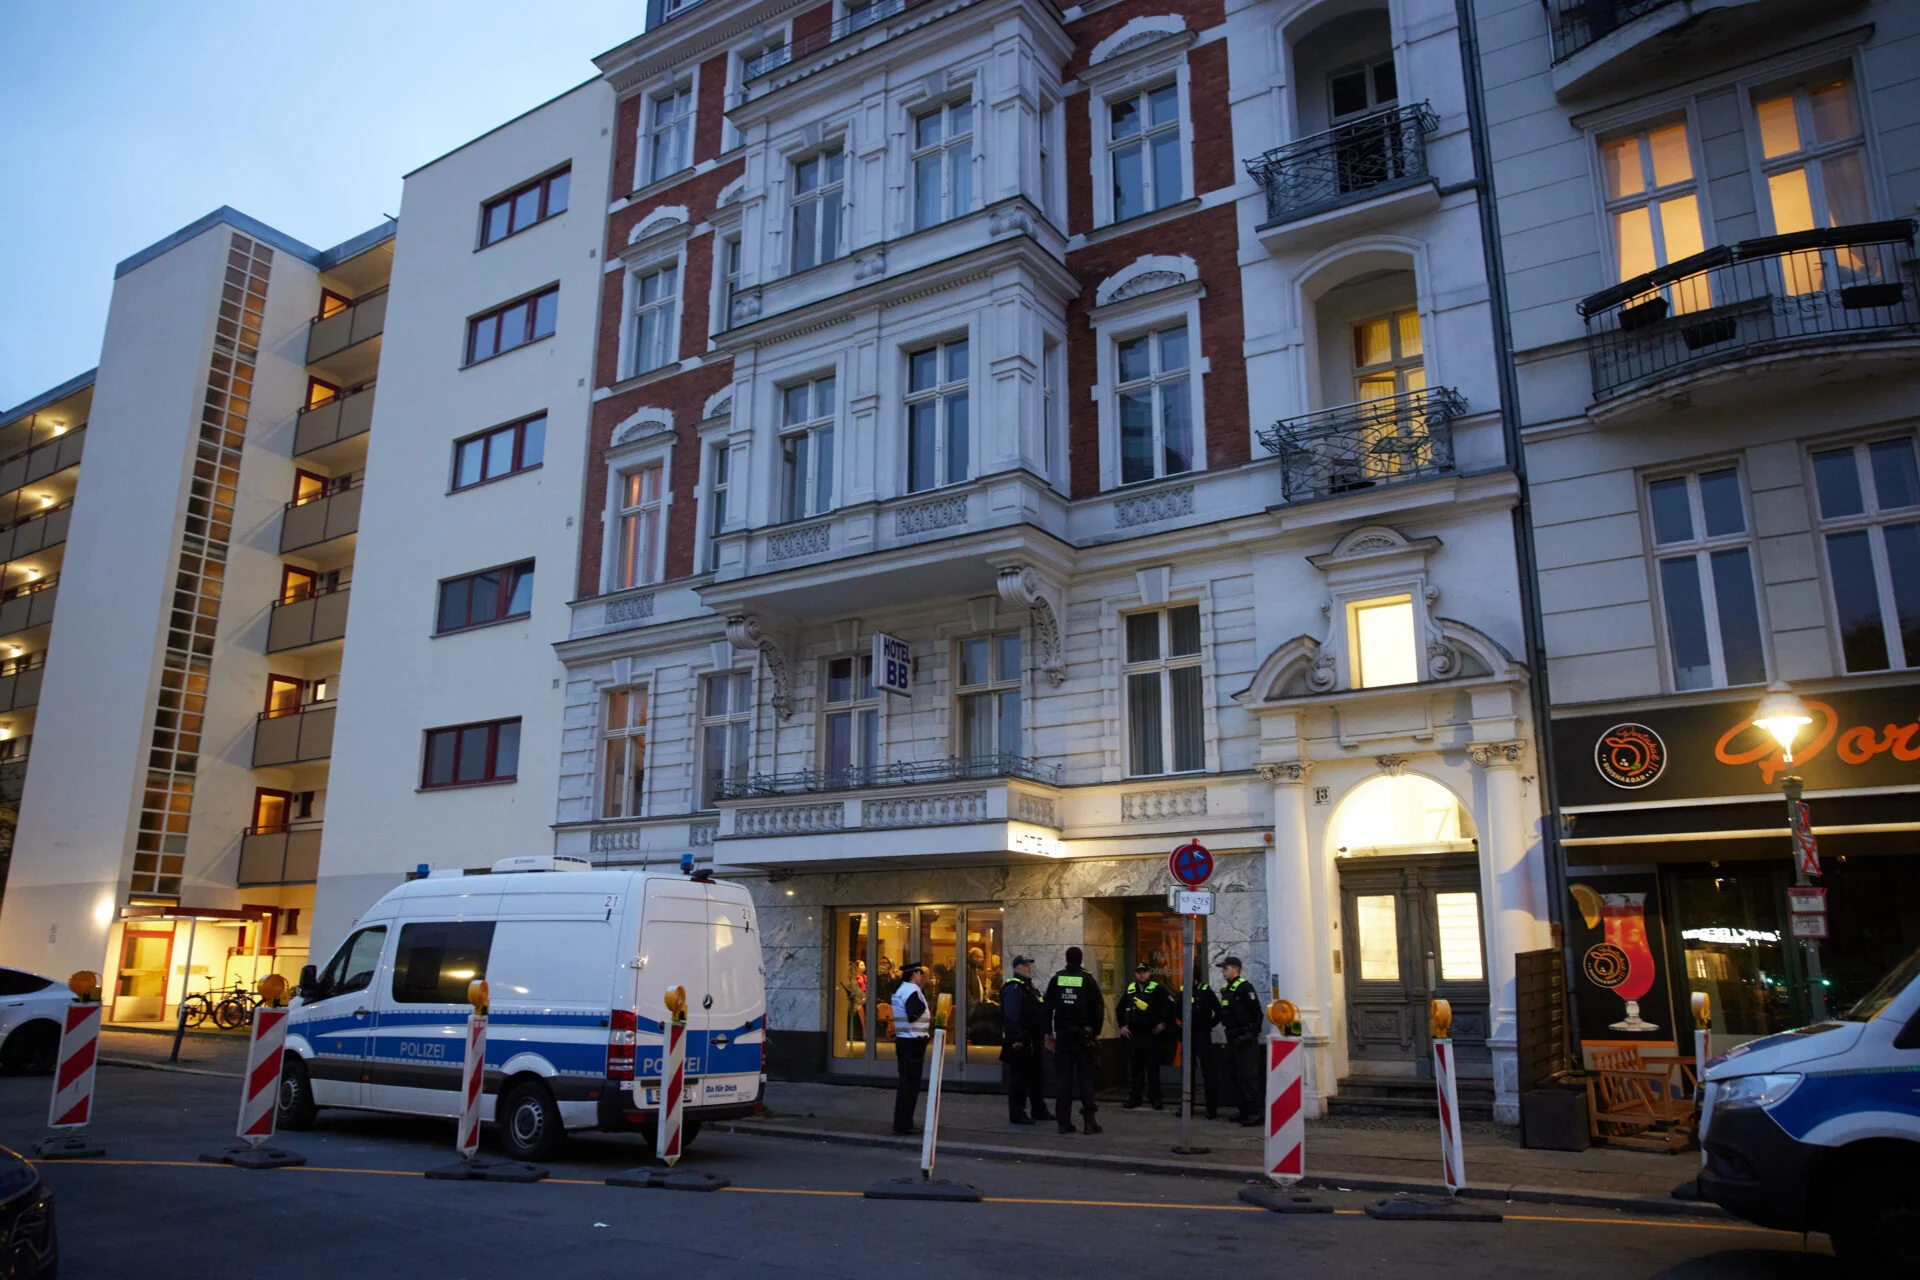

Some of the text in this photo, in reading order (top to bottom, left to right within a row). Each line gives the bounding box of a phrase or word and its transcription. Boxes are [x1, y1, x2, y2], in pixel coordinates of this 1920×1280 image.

[883, 636, 911, 665] HOTEL
[886, 660, 909, 689] BB
[1714, 700, 1920, 785] Por
[1315, 789, 1328, 803] 13
[604, 895, 619, 908] 21
[400, 1041, 446, 1059] POLIZEI
